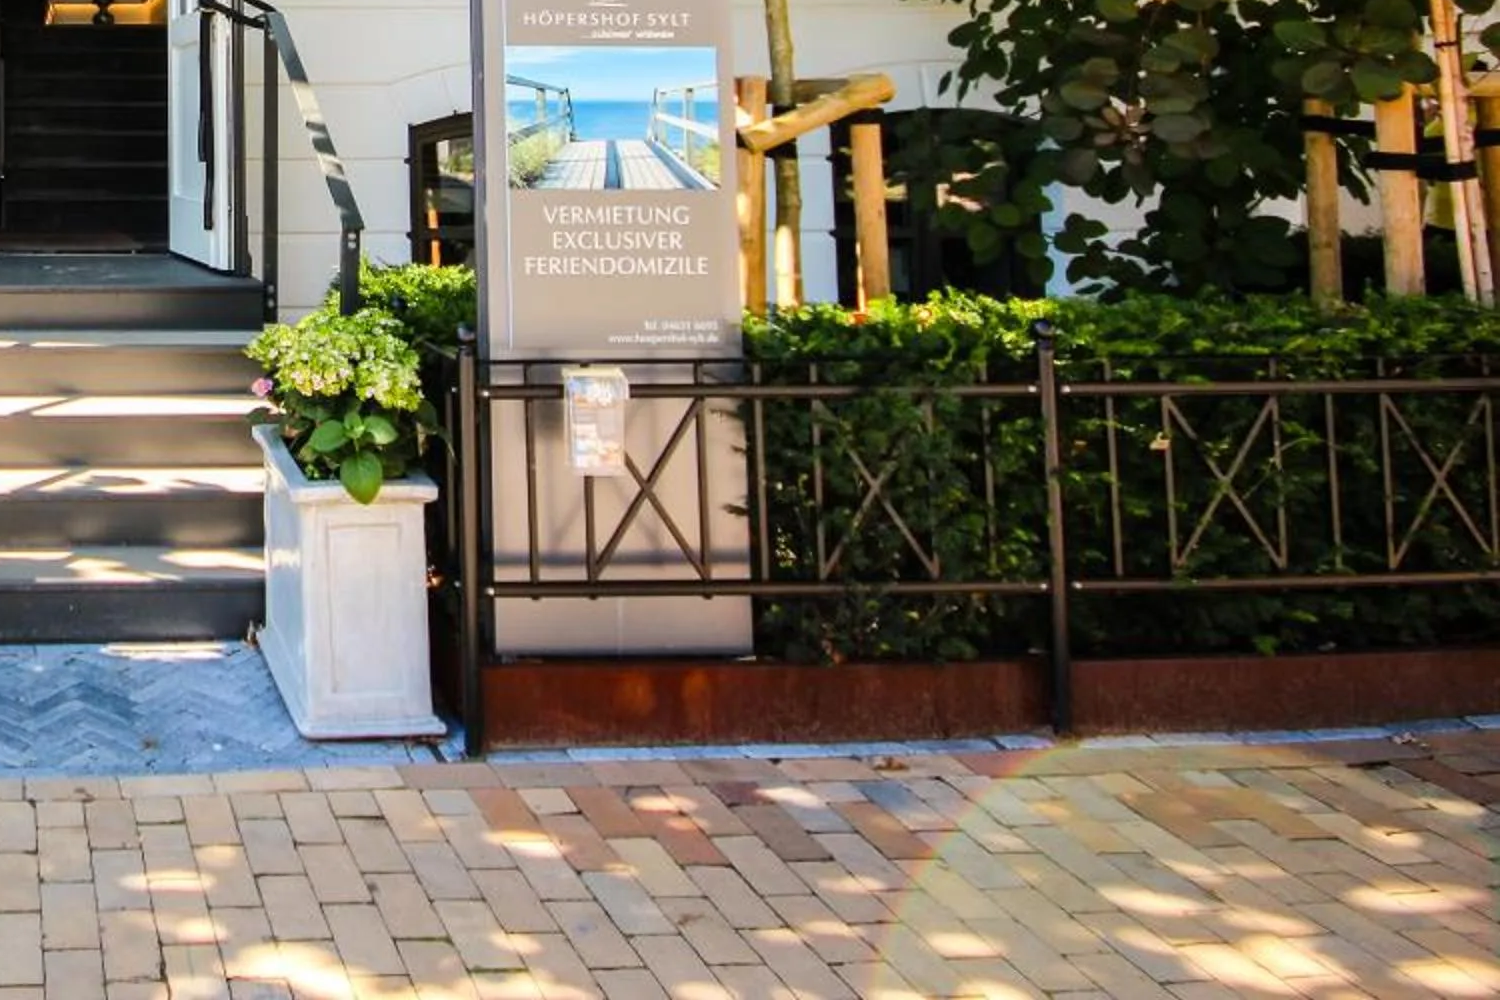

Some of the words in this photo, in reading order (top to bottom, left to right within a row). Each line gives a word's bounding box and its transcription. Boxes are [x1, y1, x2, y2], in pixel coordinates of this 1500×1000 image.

[523, 10, 641, 27] HÖPERSHOF
[647, 13, 692, 27] SYLT
[543, 204, 691, 226] VERMIETUNG
[552, 230, 683, 250] EXCLUSIVER
[523, 256, 709, 276] FERIENDOMIZILE
